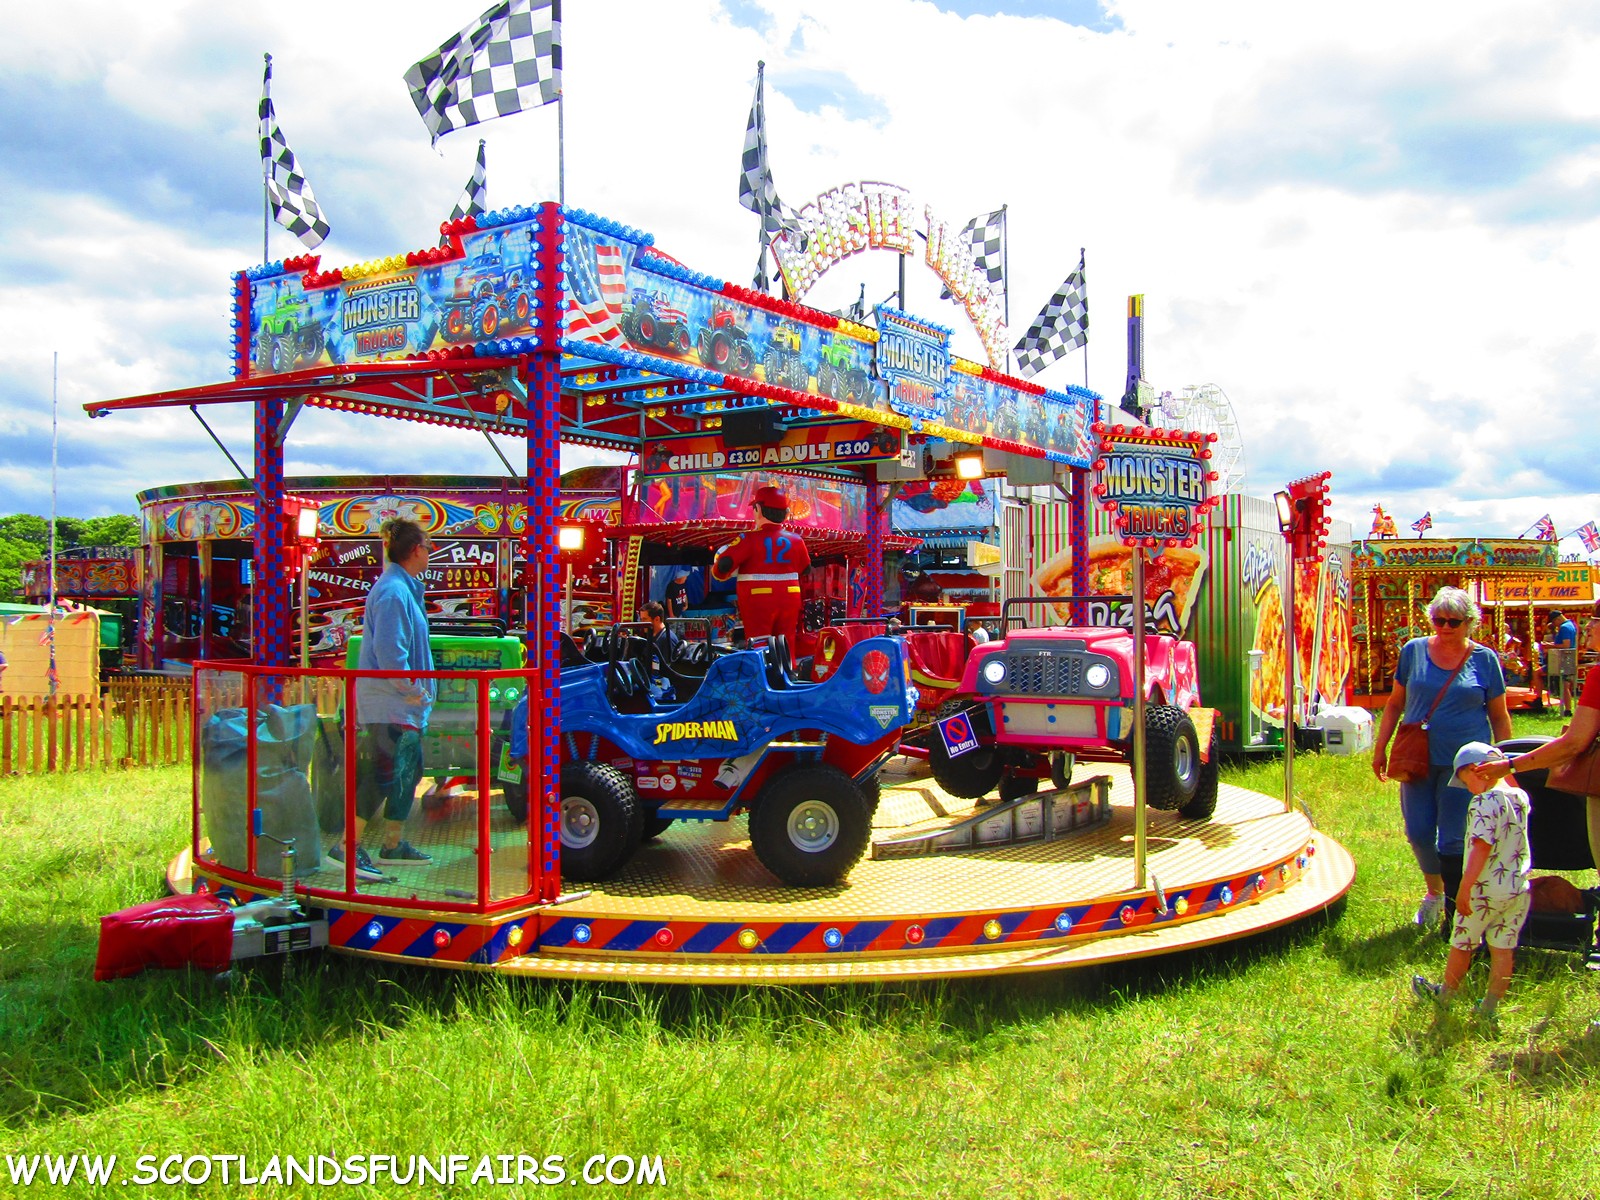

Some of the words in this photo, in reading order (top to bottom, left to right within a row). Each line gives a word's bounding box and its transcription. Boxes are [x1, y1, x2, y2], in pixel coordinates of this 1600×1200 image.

[344, 289, 419, 331] MONSTER
[356, 325, 405, 352] TRUCKS
[883, 334, 945, 384] MONSTER
[895, 377, 935, 409] TRUCKS
[668, 453, 726, 471] CHILD
[729, 450, 760, 464] £3.00
[763, 443, 831, 464] ADULT
[836, 441, 870, 456] £3.00
[1101, 455, 1204, 502] MONSTER
[1121, 504, 1188, 536] TRUCKS
[311, 547, 331, 563] ONIC
[338, 544, 371, 565] SOUNDS
[451, 544, 495, 566] RAP
[763, 537, 792, 564] 12
[308, 570, 372, 592] WALTZER
[415, 569, 444, 582] OGIE
[1549, 586, 1581, 597] TIME
[653, 720, 739, 745] SPIDER-MAN
[949, 745, 959, 755] No
[958, 739, 975, 752] Entry
